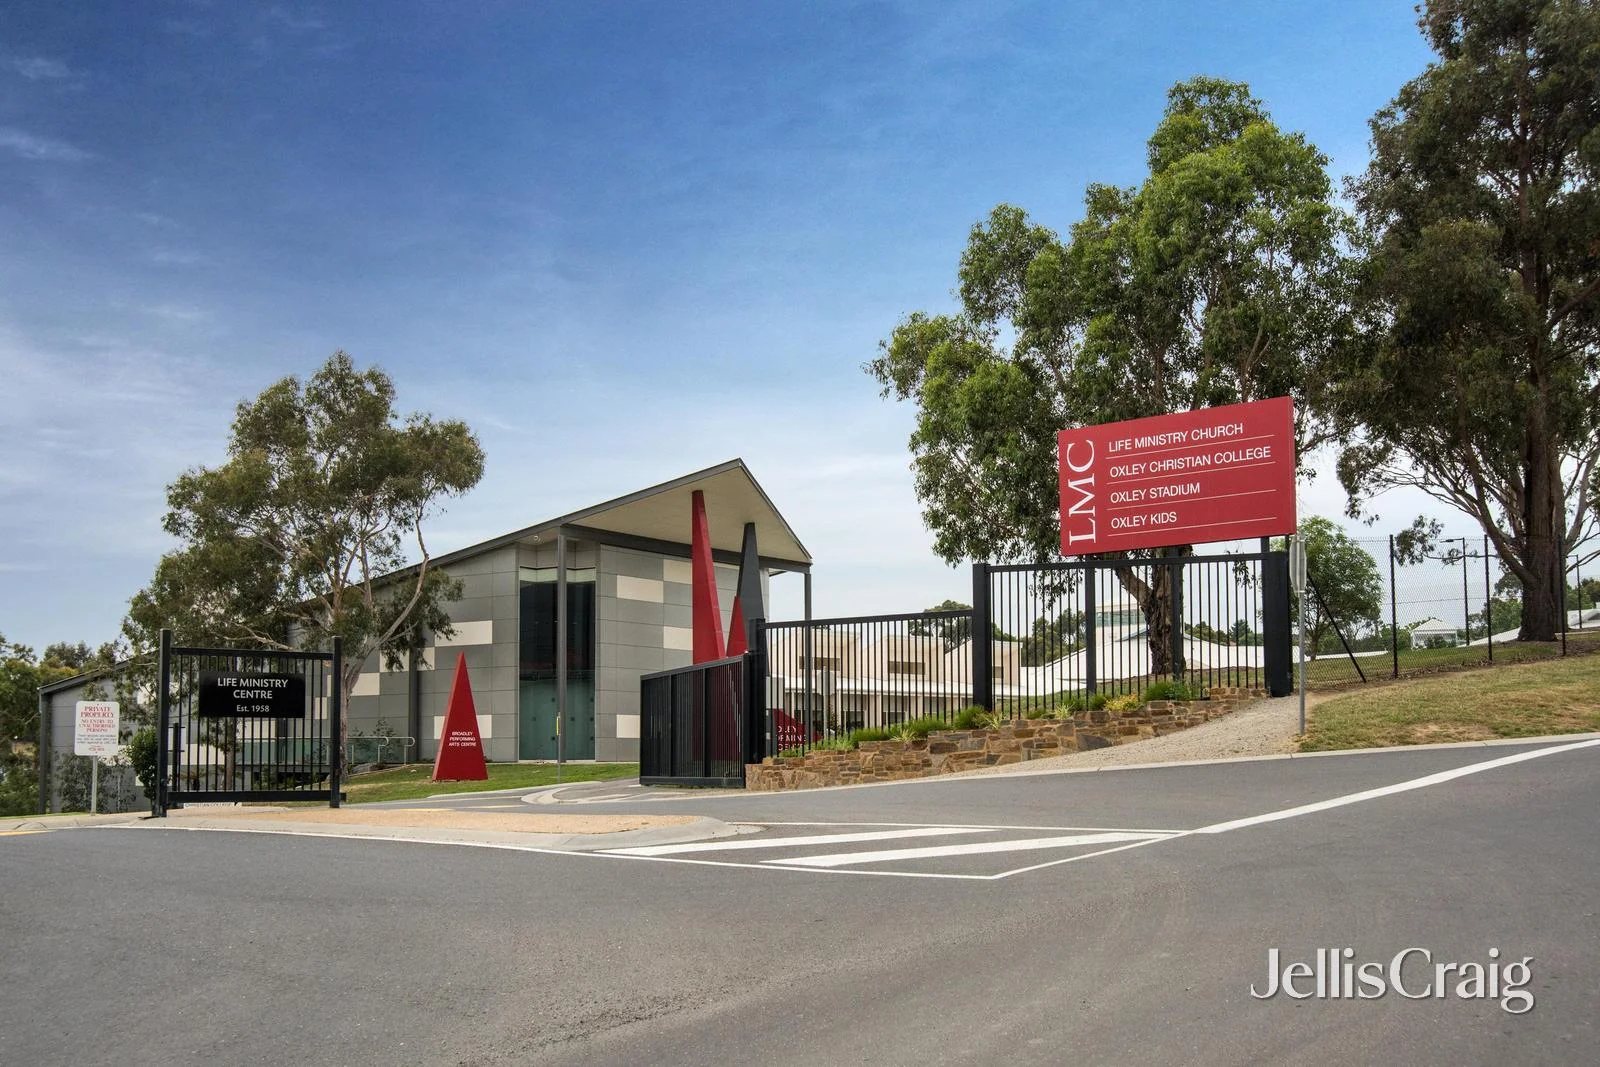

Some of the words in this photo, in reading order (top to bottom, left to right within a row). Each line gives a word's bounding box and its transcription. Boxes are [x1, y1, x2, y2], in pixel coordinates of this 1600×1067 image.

[1109, 439, 1131, 452] LIFE
[1135, 431, 1188, 448] MINISTRY
[1191, 423, 1243, 440] CHURCH
[1110, 463, 1146, 477] OXLEY
[1149, 454, 1211, 473] CHRISTIAN
[1214, 446, 1271, 464] COLLEGE
[1066, 439, 1096, 546] LMC
[1110, 489, 1147, 503] OXLEY
[1149, 483, 1200, 499] STADIUM
[1111, 515, 1147, 529] OXLEY
[1150, 512, 1177, 524] KIDS
[217, 678, 237, 686] LIFE
[239, 678, 288, 687] MINISTRY
[233, 690, 273, 699] CENTRE
